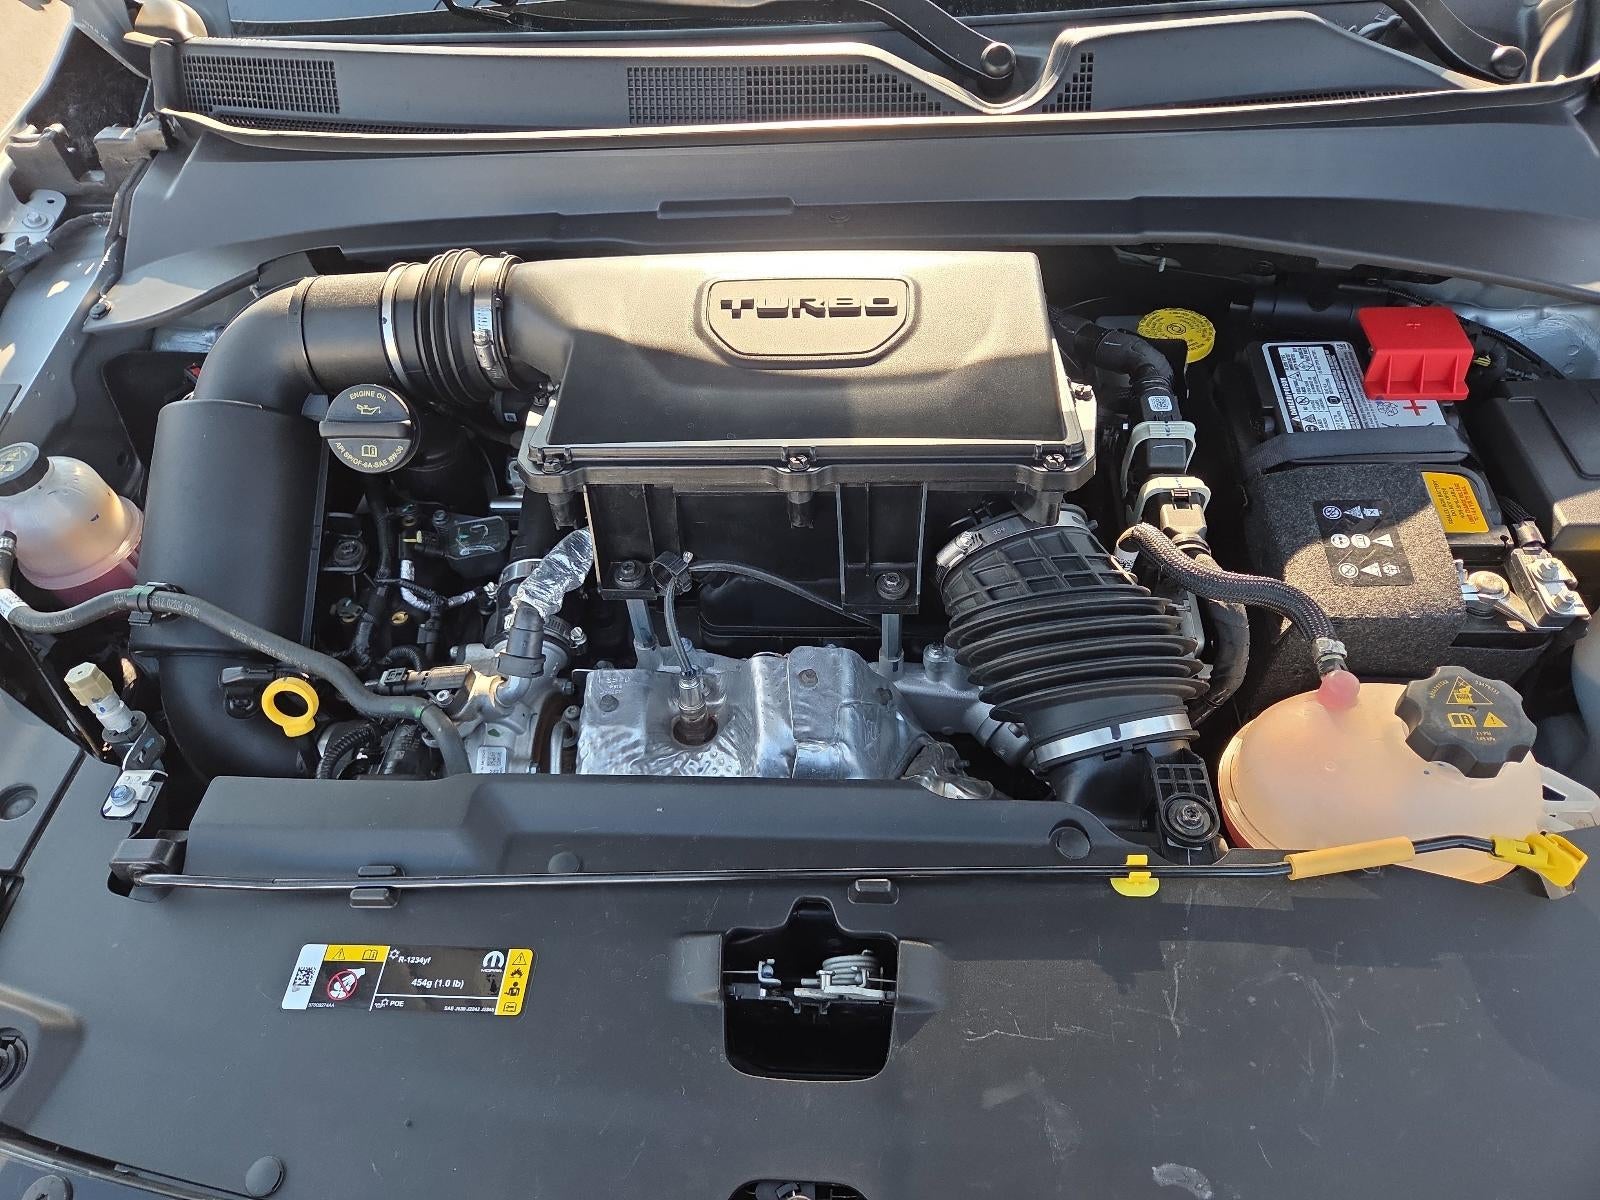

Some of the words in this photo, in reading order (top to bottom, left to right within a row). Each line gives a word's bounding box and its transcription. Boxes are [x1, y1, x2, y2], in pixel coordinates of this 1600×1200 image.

[720, 297, 898, 319] TURBO
[349, 390, 375, 400] ENGINE
[376, 392, 387, 402] OIL
[335, 442, 345, 454] API
[1431, 479, 1443, 497] BATTERY
[398, 956, 431, 965] R-1234yf
[411, 978, 433, 988] 454g
[434, 979, 450, 989] (1.0
[452, 980, 464, 990] lb)
